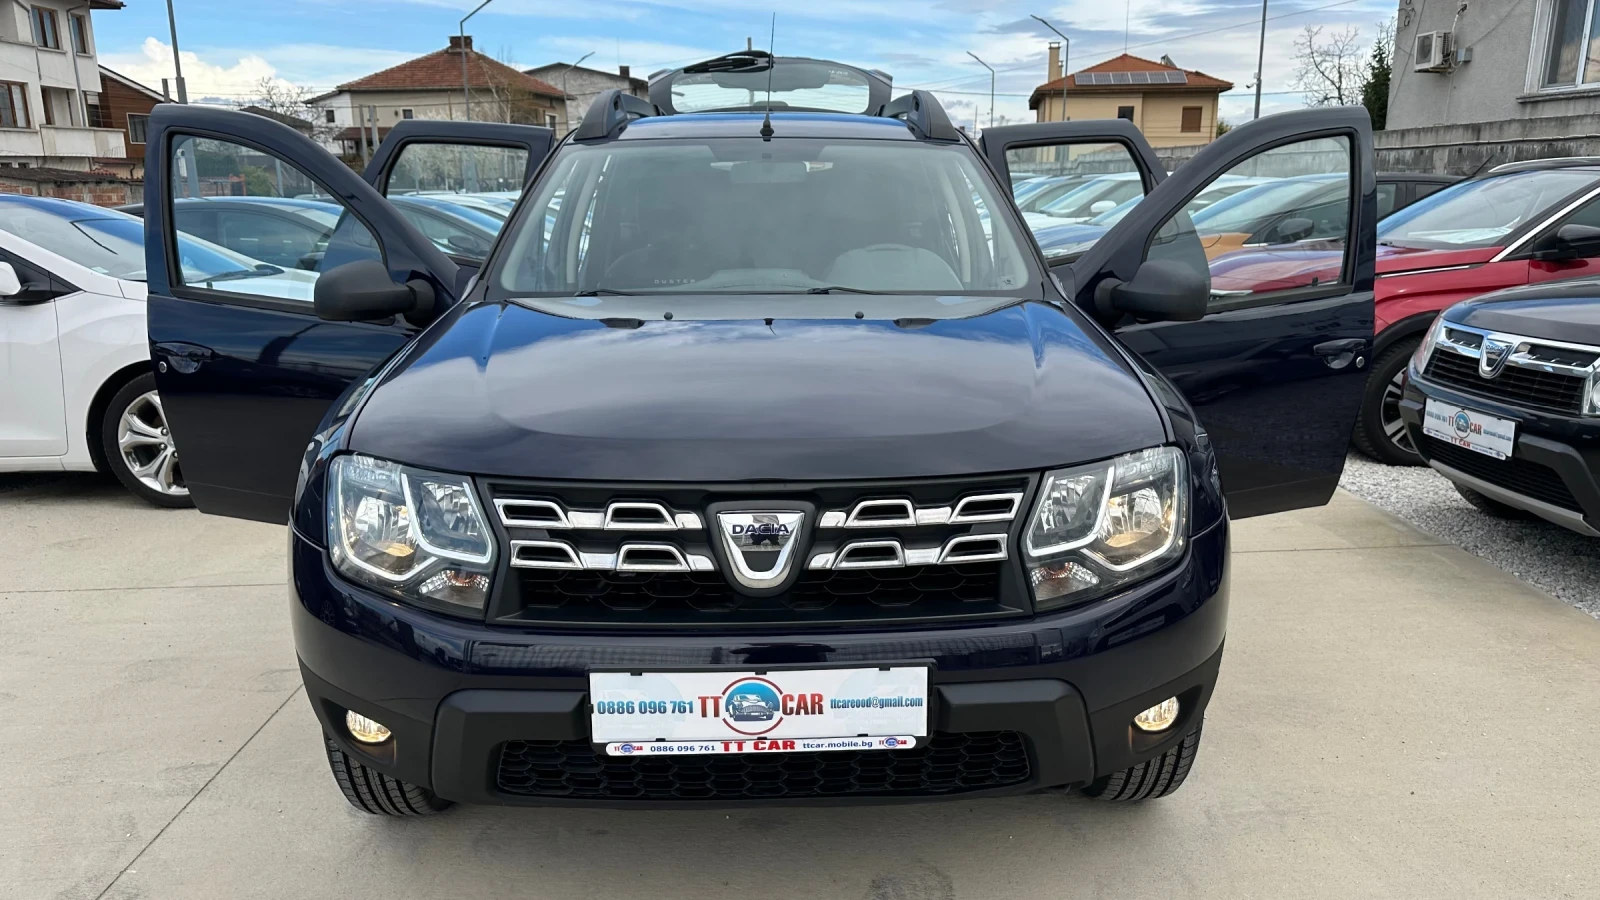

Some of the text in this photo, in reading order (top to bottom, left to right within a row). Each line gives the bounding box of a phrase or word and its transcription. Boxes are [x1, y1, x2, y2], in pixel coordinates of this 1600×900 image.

[1470, 422, 1482, 436] CAR
[732, 523, 790, 535] DACIA
[597, 700, 694, 714] 0886 096 761
[698, 693, 824, 718] TT CAR
[830, 696, 923, 710] ttcareood@gmail.com
[720, 740, 796, 752] TT CAR
[802, 740, 873, 750] ttcar.mobile.bg
